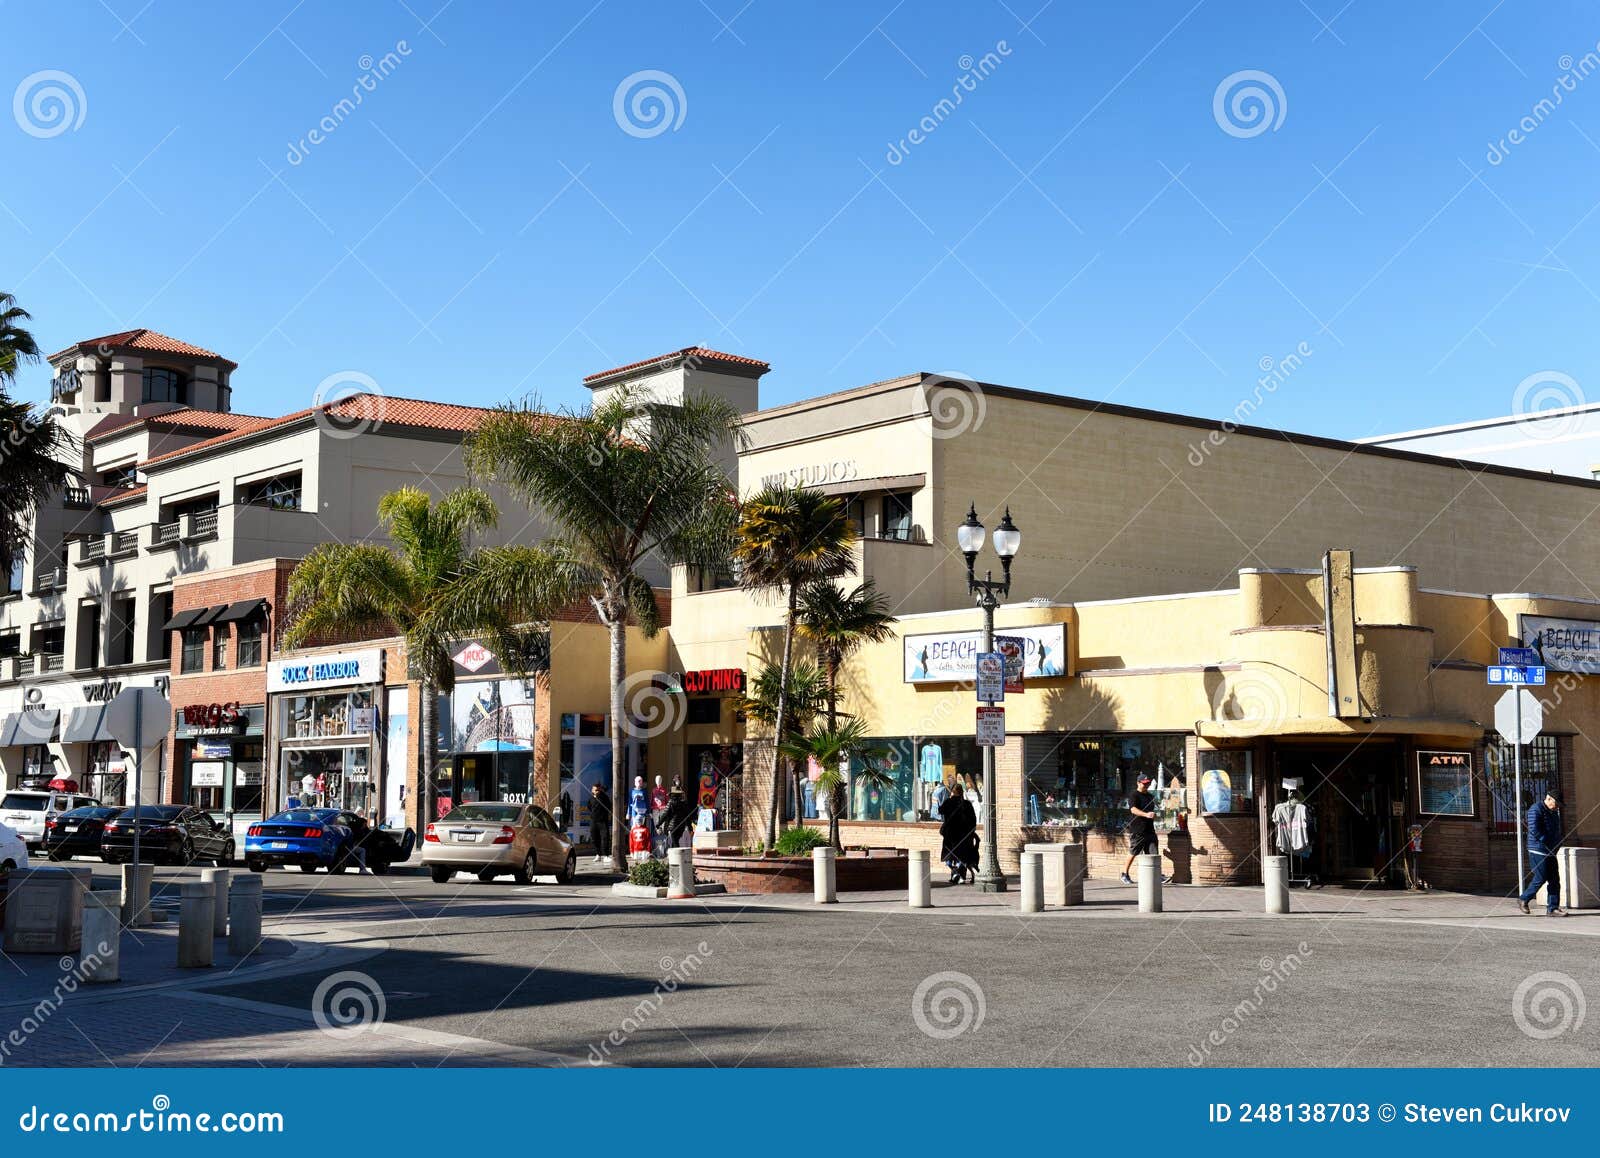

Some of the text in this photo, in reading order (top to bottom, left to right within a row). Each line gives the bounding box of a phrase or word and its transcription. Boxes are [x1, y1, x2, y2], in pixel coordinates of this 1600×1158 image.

[789, 459, 857, 487] STUDIOS
[1547, 628, 1590, 652] BEACH
[932, 640, 977, 660] BEACH
[282, 661, 359, 683] SOCK HARBOR
[685, 668, 742, 691] CLOTHING
[1504, 668, 1528, 682] Main
[93, 682, 122, 701] ROXY
[1079, 742, 1099, 750] ATM
[1430, 756, 1464, 764] ATM
[503, 793, 526, 803] ROXY
